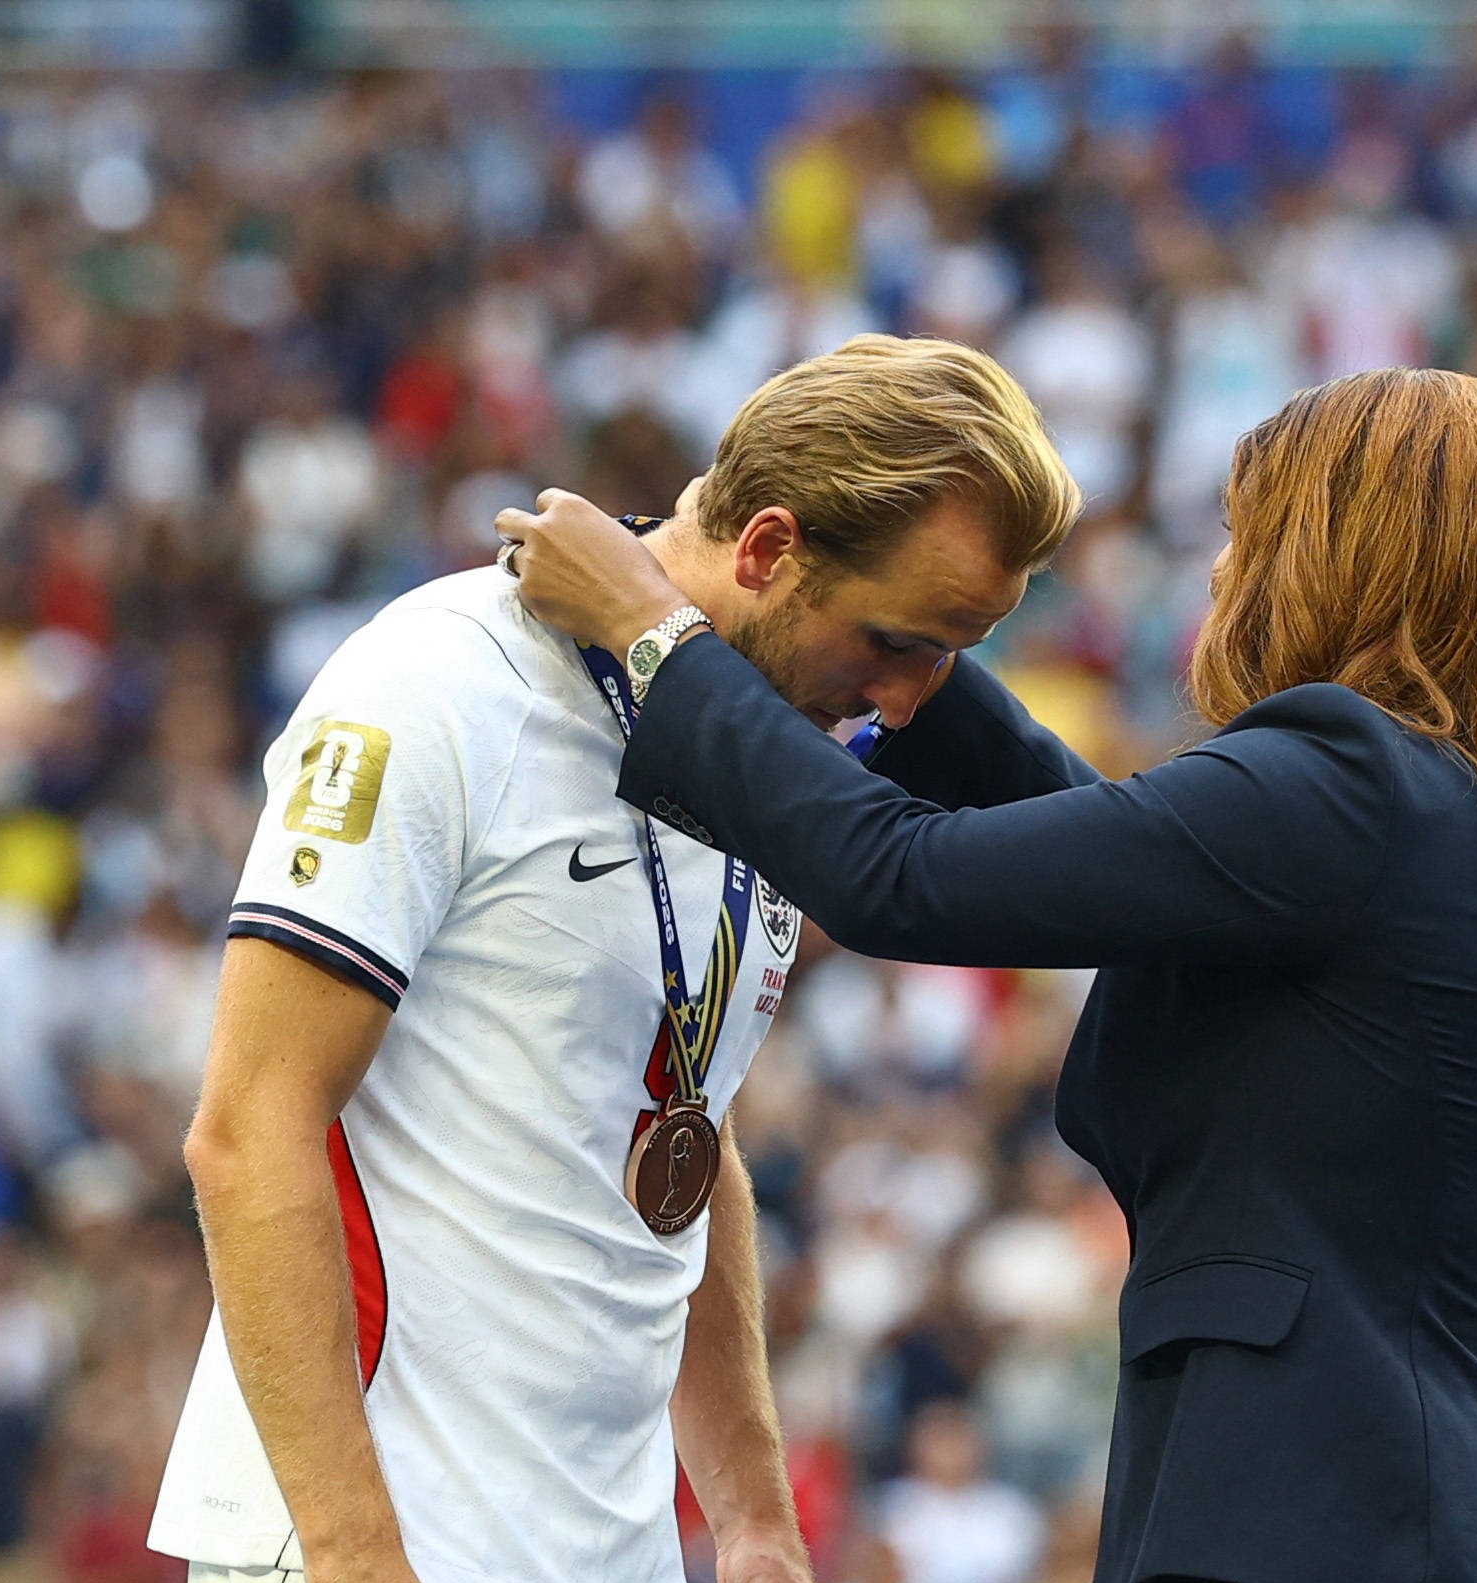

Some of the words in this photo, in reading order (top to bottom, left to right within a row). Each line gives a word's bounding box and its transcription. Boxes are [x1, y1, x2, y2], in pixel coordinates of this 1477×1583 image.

[603, 676, 631, 739] 026
[654, 862, 675, 946] 2026
[731, 857, 747, 893] FIF
